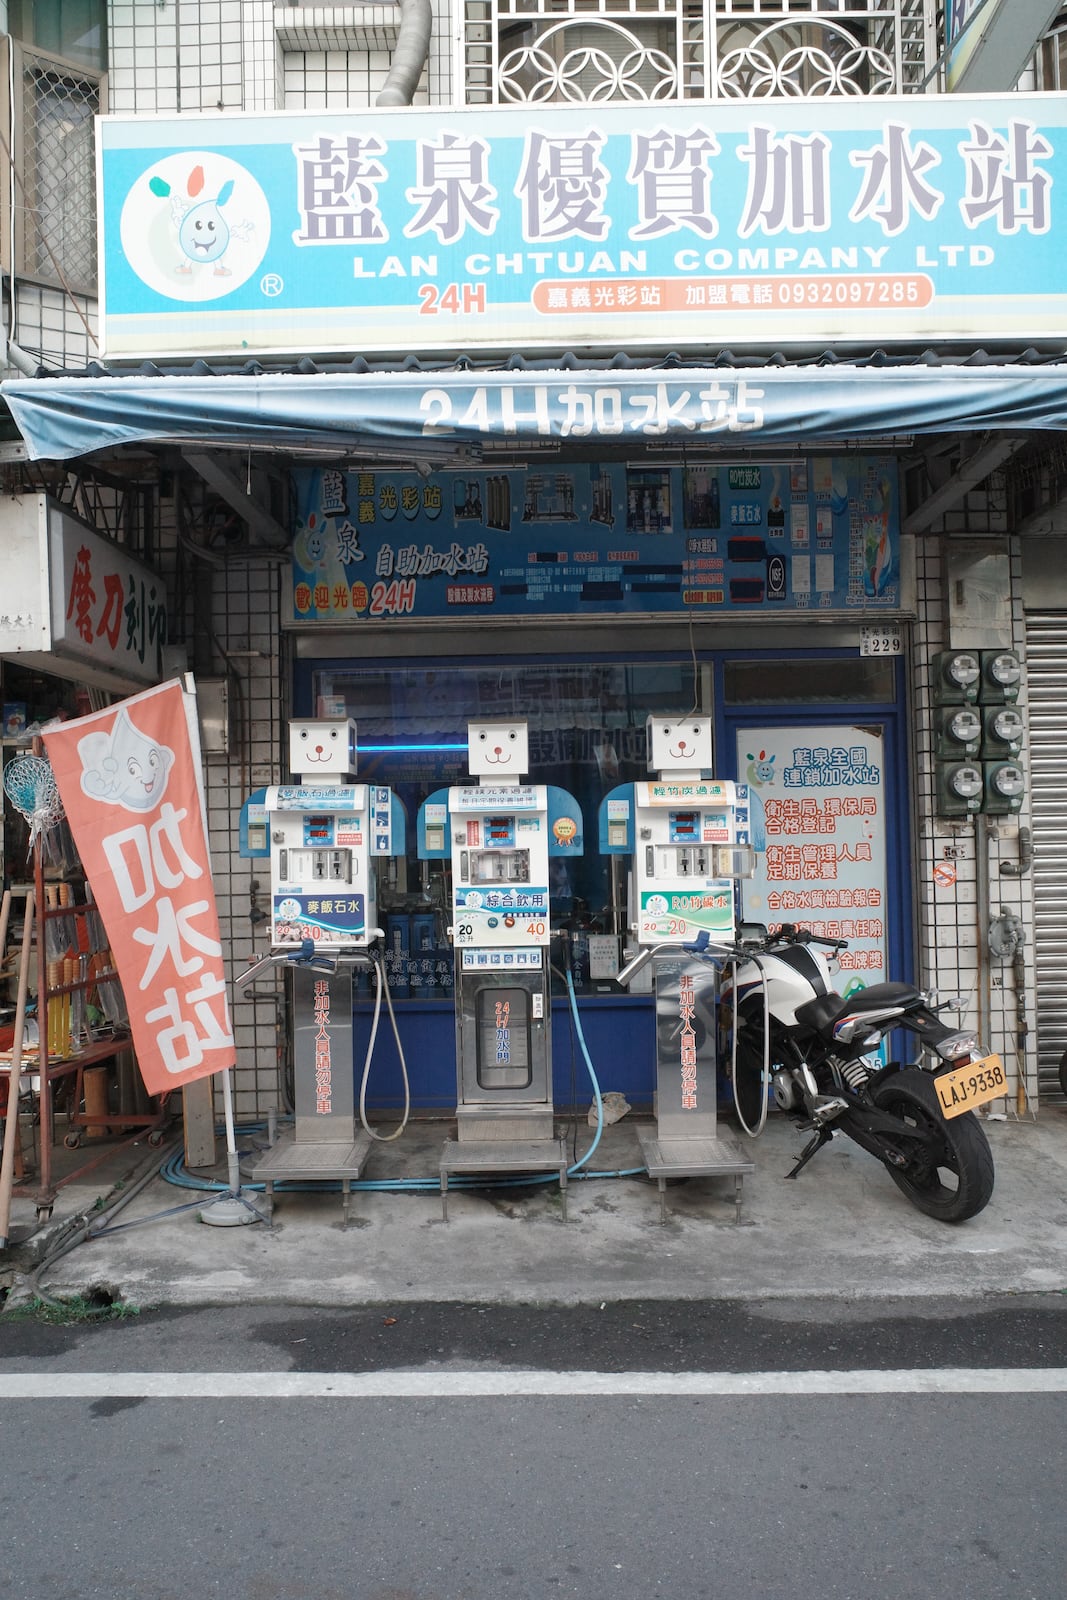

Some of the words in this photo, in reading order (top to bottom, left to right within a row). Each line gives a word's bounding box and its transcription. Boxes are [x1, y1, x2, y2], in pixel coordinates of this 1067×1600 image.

[294, 119, 1053, 246] 藍泉優質加水站
[353, 253, 438, 278] LAN
[465, 250, 647, 275] CHTUAN
[673, 246, 890, 271] COMPANY
[916, 244, 996, 268] LTD
[417, 282, 487, 315] 24H
[547, 282, 661, 309] 嘉義光彩站
[419, 381, 766, 437] 24H加水站
[358, 473, 376, 524] 嘉義
[379, 485, 442, 511] 光彩站
[321, 471, 365, 565] 藍泉
[375, 543, 489, 577] 自助加水站
[295, 585, 368, 610] 歡迎光臨
[370, 578, 417, 615] 24H
[872, 638, 900, 652] 229
[793, 746, 867, 767] 藍泉全國
[783, 766, 880, 788] 連鎖加水站
[765, 816, 836, 835] 合格登記
[765, 842, 872, 864] 衛生管理人員
[766, 862, 838, 881] 定期保養
[307, 899, 360, 914] 麥飯石水
[486, 894, 544, 907] 綜合飲用
[767, 887, 882, 910] 合格水質檢驗報告
[277, 926, 290, 934] 20
[301, 925, 321, 940] 30
[458, 924, 473, 935] 20
[526, 922, 545, 936] 40
[643, 923, 657, 931] 20
[669, 919, 687, 935] 20
[313, 979, 332, 1115] 非加水人員請勿停車
[678, 974, 698, 1110] 非加水人員請勿停車
[940, 1066, 1004, 1109] LAJ-9338
